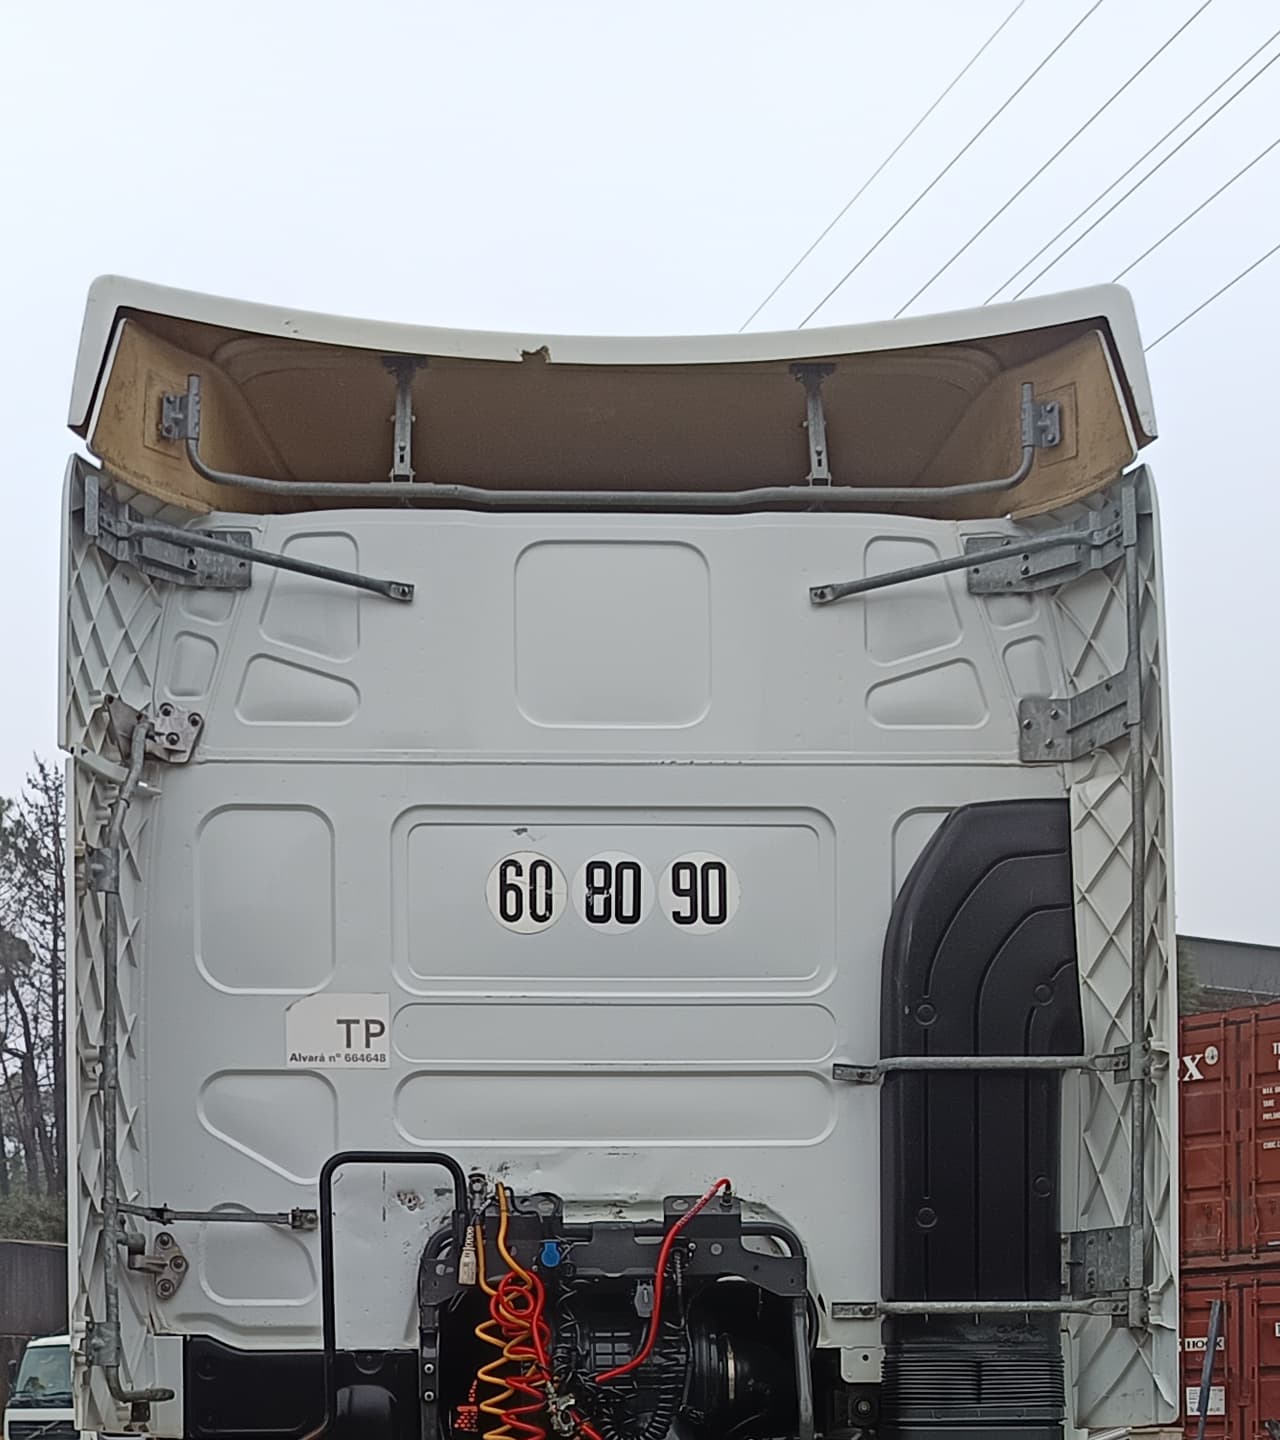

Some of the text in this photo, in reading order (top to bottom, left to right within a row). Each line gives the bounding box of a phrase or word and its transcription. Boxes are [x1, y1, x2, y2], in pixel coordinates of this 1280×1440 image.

[499, 858, 553, 923] 60
[585, 860, 641, 924] 80
[672, 861, 727, 925] 90
[289, 1052, 326, 1063] Alvará
[336, 1018, 386, 1049] TP
